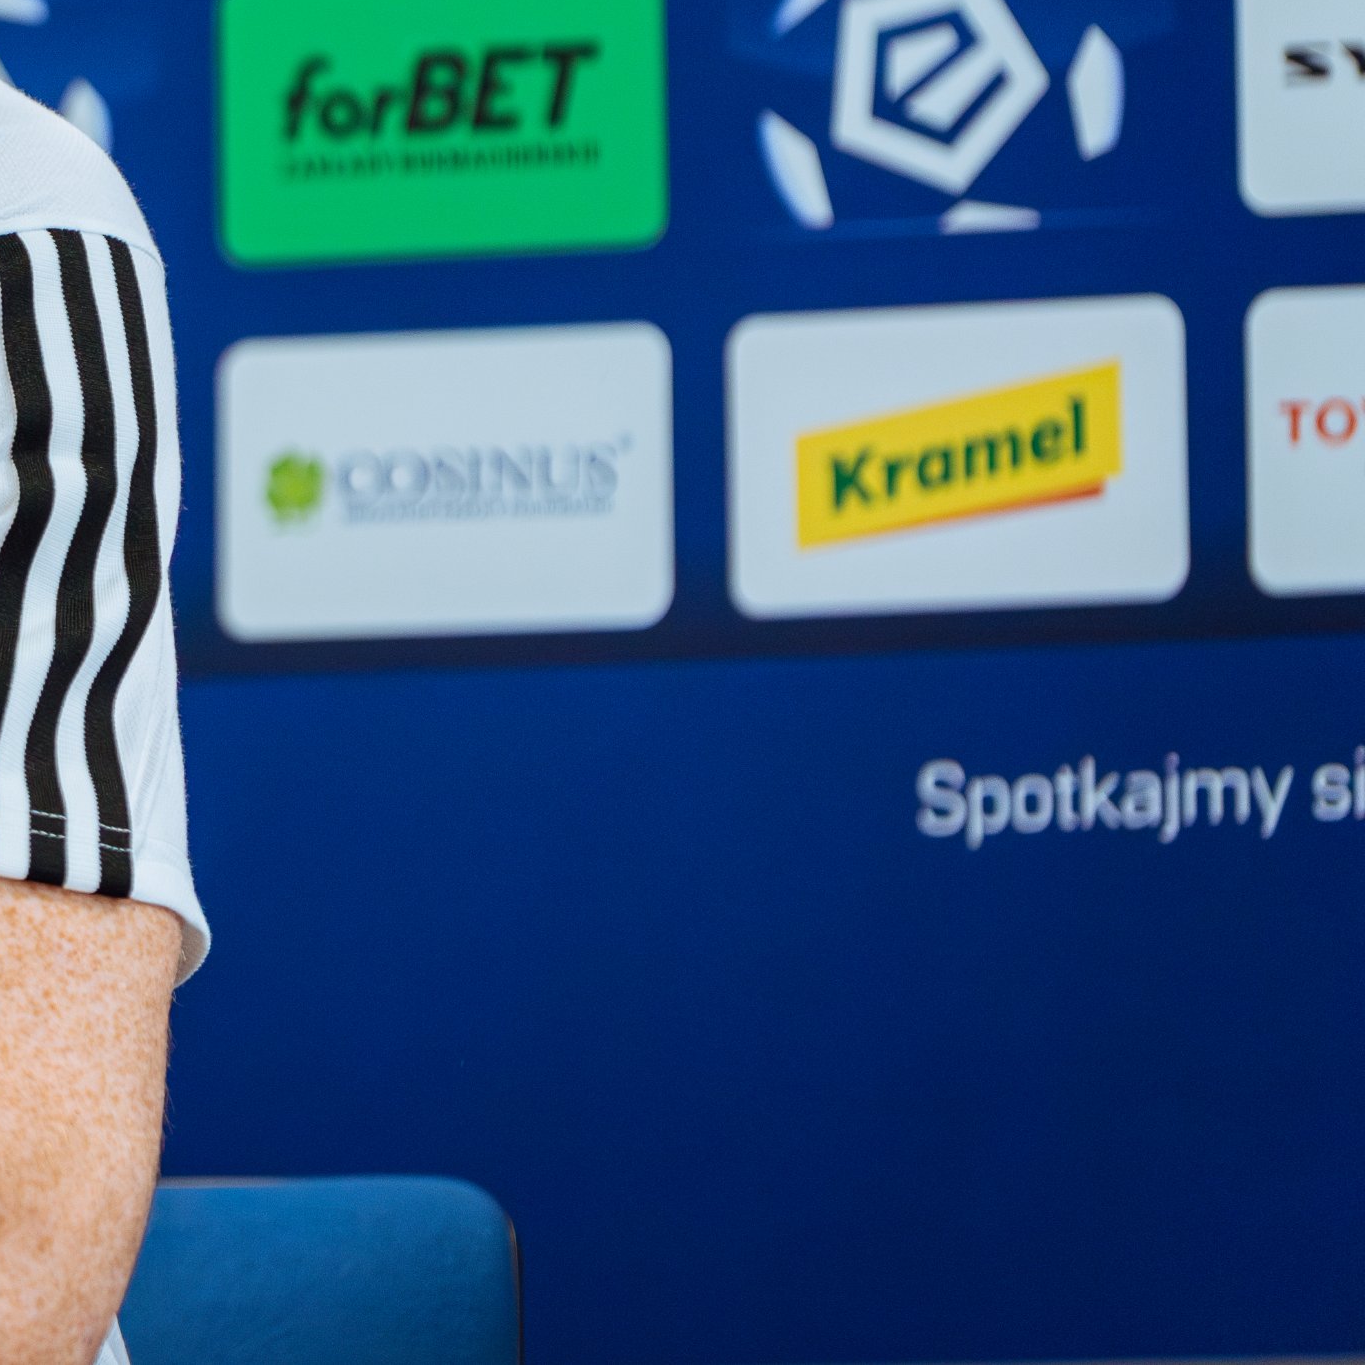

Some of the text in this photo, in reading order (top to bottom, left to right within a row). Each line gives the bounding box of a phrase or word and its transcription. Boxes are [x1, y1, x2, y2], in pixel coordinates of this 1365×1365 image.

[281, 37, 602, 144] forBET
[827, 394, 1091, 516] Kramel
[915, 750, 1295, 852] Spotkajmy
